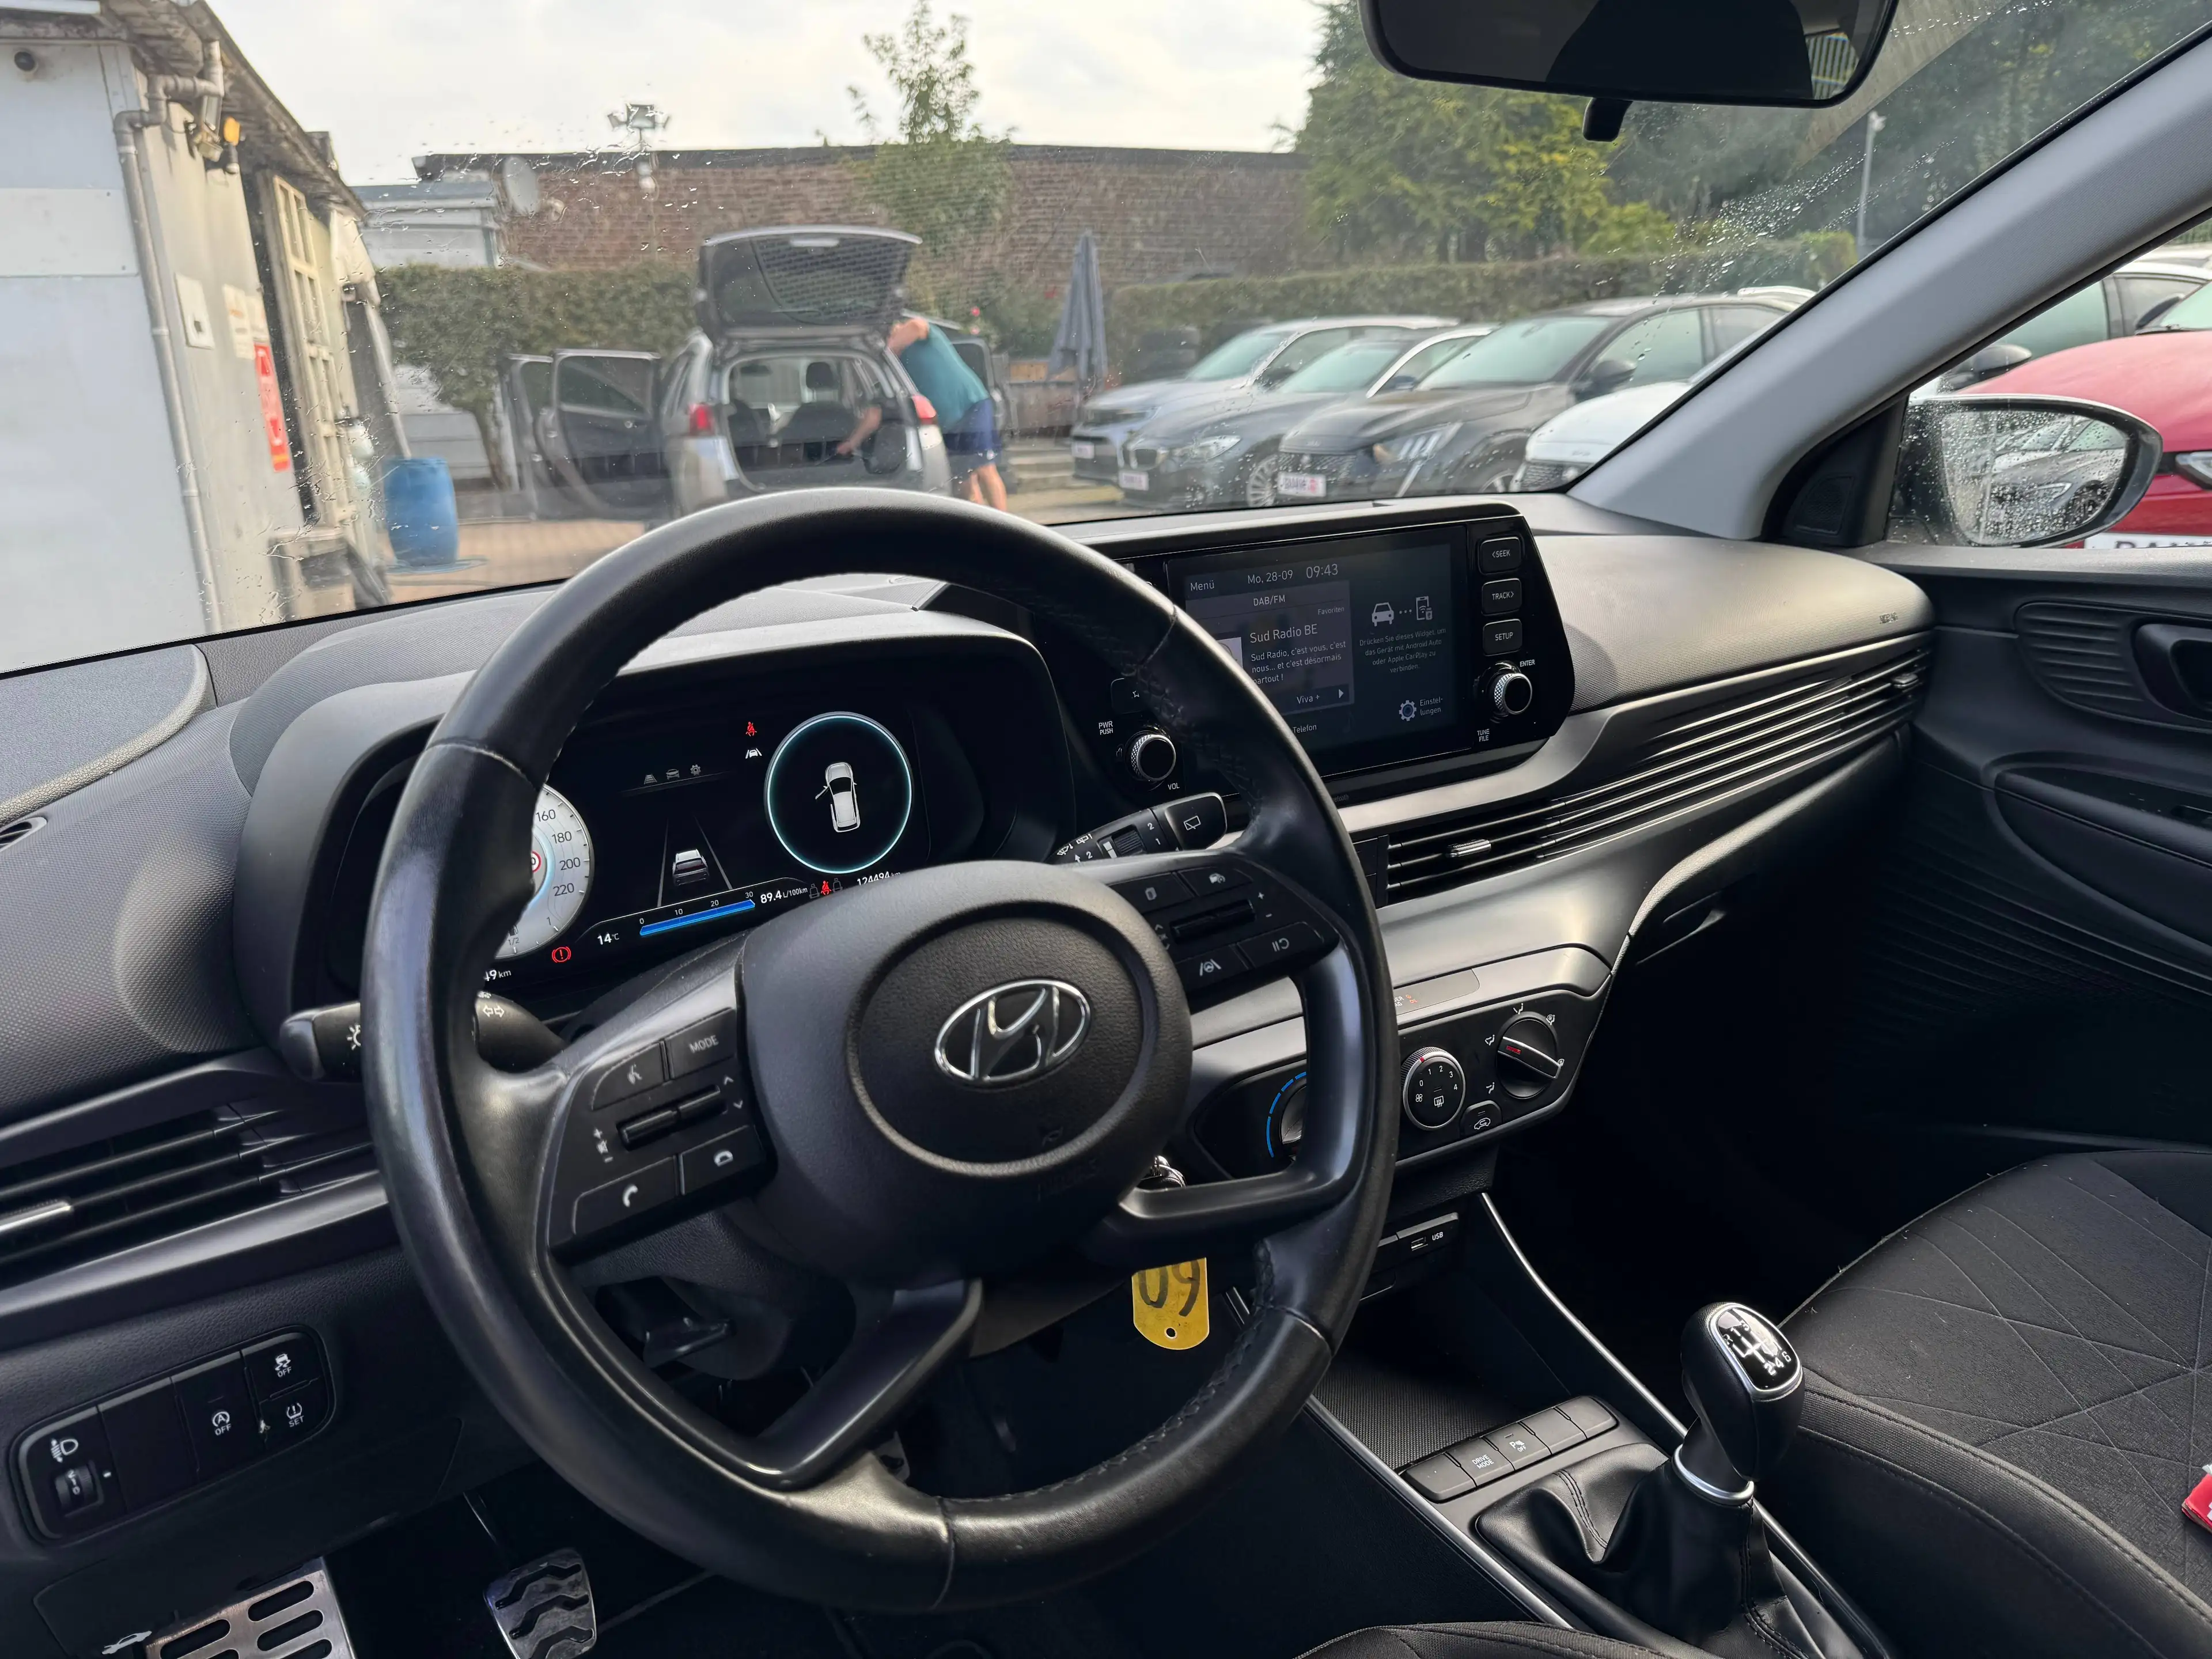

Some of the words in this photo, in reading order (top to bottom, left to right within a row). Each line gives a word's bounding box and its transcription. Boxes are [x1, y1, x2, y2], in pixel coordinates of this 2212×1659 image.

[1190, 580, 1214, 591] Menü
[1266, 570, 1293, 582] 28-09
[1306, 564, 1338, 578] 09:43
[1253, 594, 1286, 606] DAB/FM
[1317, 607, 1344, 615] Favoriten
[1250, 631, 1270, 643] Sud
[1273, 627, 1301, 640] Radio
[1304, 624, 1318, 635] BE
[1359, 637, 1384, 646] Drücken
[1395, 633, 1414, 641] dieses
[1495, 632, 1513, 641] SETUP
[1251, 653, 1265, 661] Sud
[1267, 650, 1289, 659] Radio,
[1291, 647, 1308, 656] c'est
[1330, 641, 1346, 649] c'est
[1377, 646, 1393, 654] Gerät
[1406, 641, 1427, 650] Android
[1252, 664, 1275, 673] nous...
[1286, 659, 1302, 668] c'est
[1304, 653, 1342, 665] désormais
[1388, 655, 1404, 664] Apple
[1405, 652, 1427, 660] CarPlay
[1297, 695, 1313, 704] Viva
[1419, 696, 1443, 706] Einstel-
[1420, 707, 1441, 716] lungen
[1099, 721, 1113, 729] PWR
[1293, 724, 1317, 734] Telefon
[535, 809, 556, 822] 160
[552, 831, 571, 844] 180
[559, 857, 581, 871] 200
[553, 883, 574, 896] 220
[710, 899, 719, 907] 20
[760, 891, 782, 904] 89.4
[547, 917, 552, 925] 1
[508, 937, 520, 945] 1/2
[498, 970, 512, 979] km
[689, 1035, 719, 1054] MODE
[1432, 1232, 1444, 1241] USB
[1775, 1357, 1785, 1368] 4
[1781, 1351, 1791, 1363] 6
[277, 1366, 292, 1377] OFF
[1764, 1363, 1777, 1376] 2
[289, 1415, 304, 1427] SET
[214, 1423, 232, 1435] OFF
[1472, 1454, 1490, 1465] DRIVE
[1476, 1459, 1494, 1469] MODE
